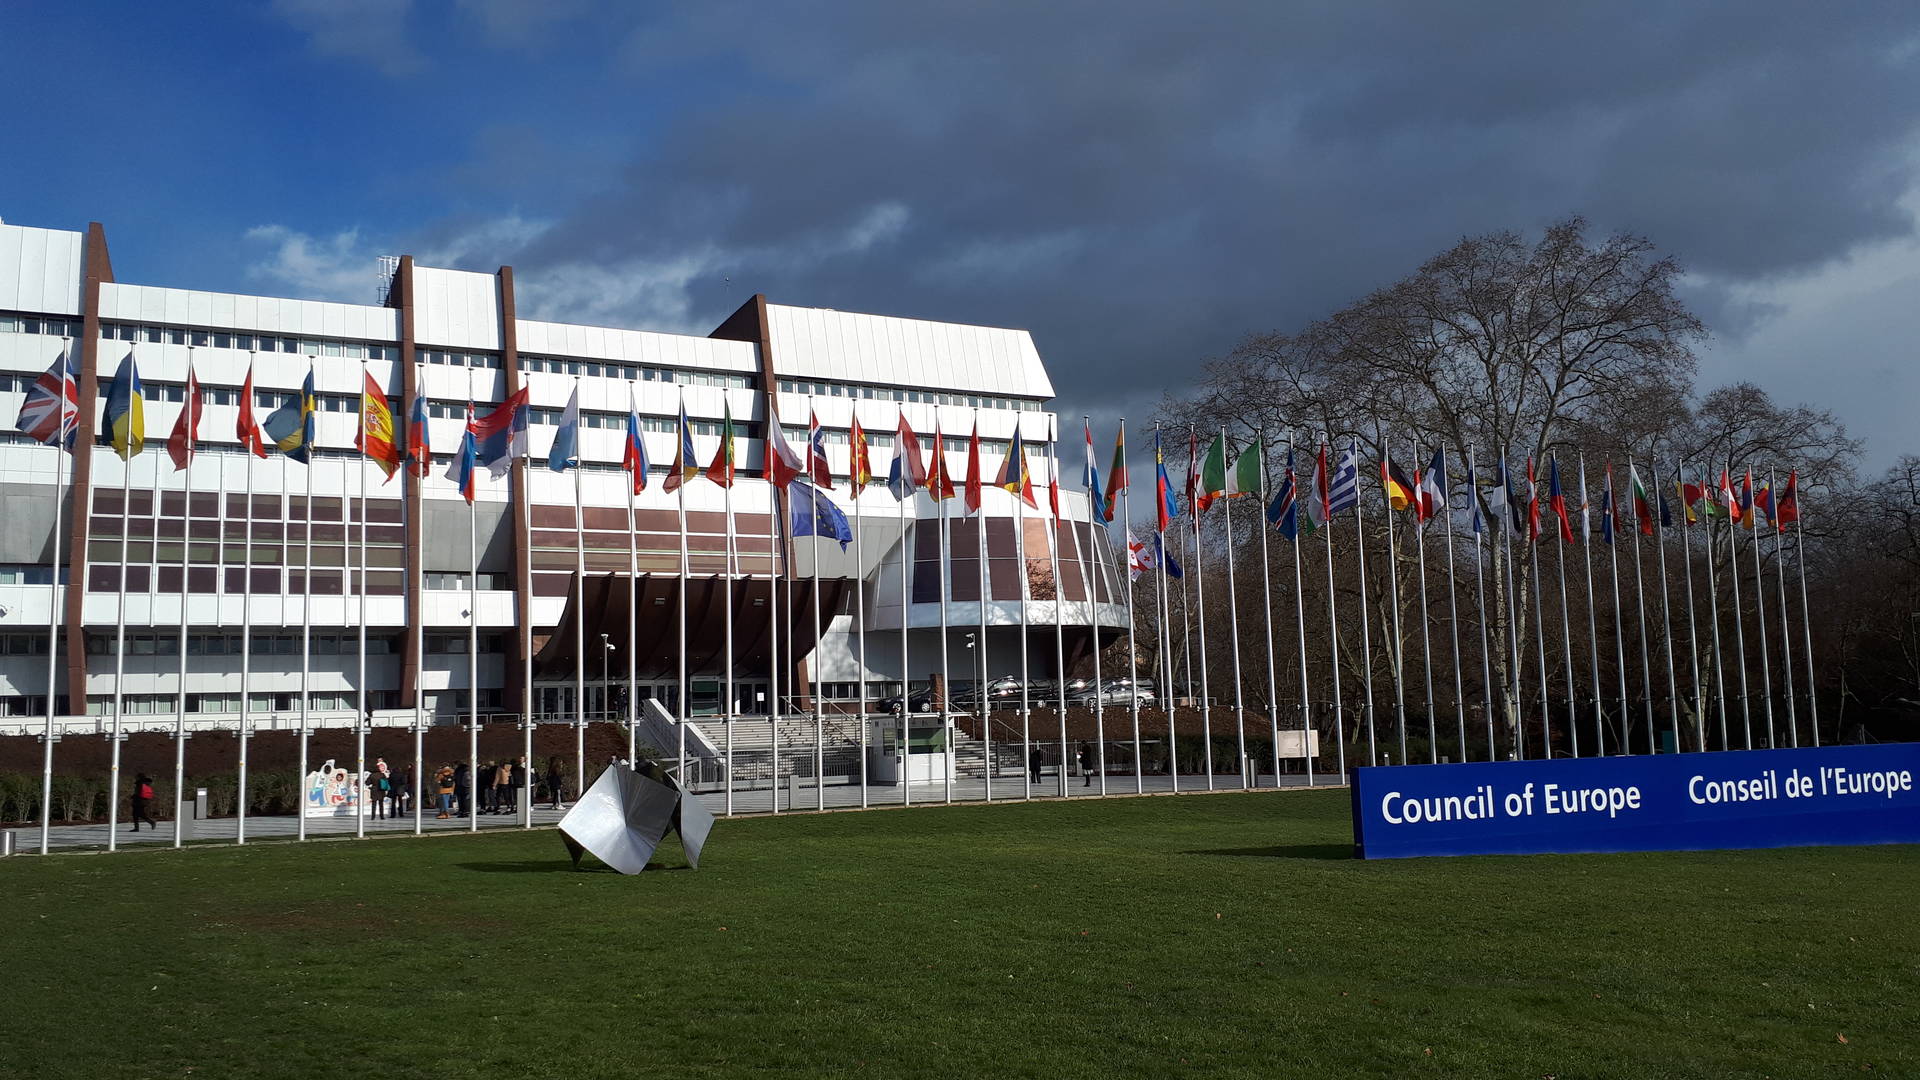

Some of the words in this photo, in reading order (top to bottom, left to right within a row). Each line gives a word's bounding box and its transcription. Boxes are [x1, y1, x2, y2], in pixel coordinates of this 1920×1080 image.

[1382, 785, 1494, 824] Council
[1504, 782, 1535, 817] of
[1544, 783, 1641, 818] Europe
[1688, 770, 1777, 805] Conseil
[1785, 768, 1813, 798] de
[1820, 767, 1912, 799] l'Europe
